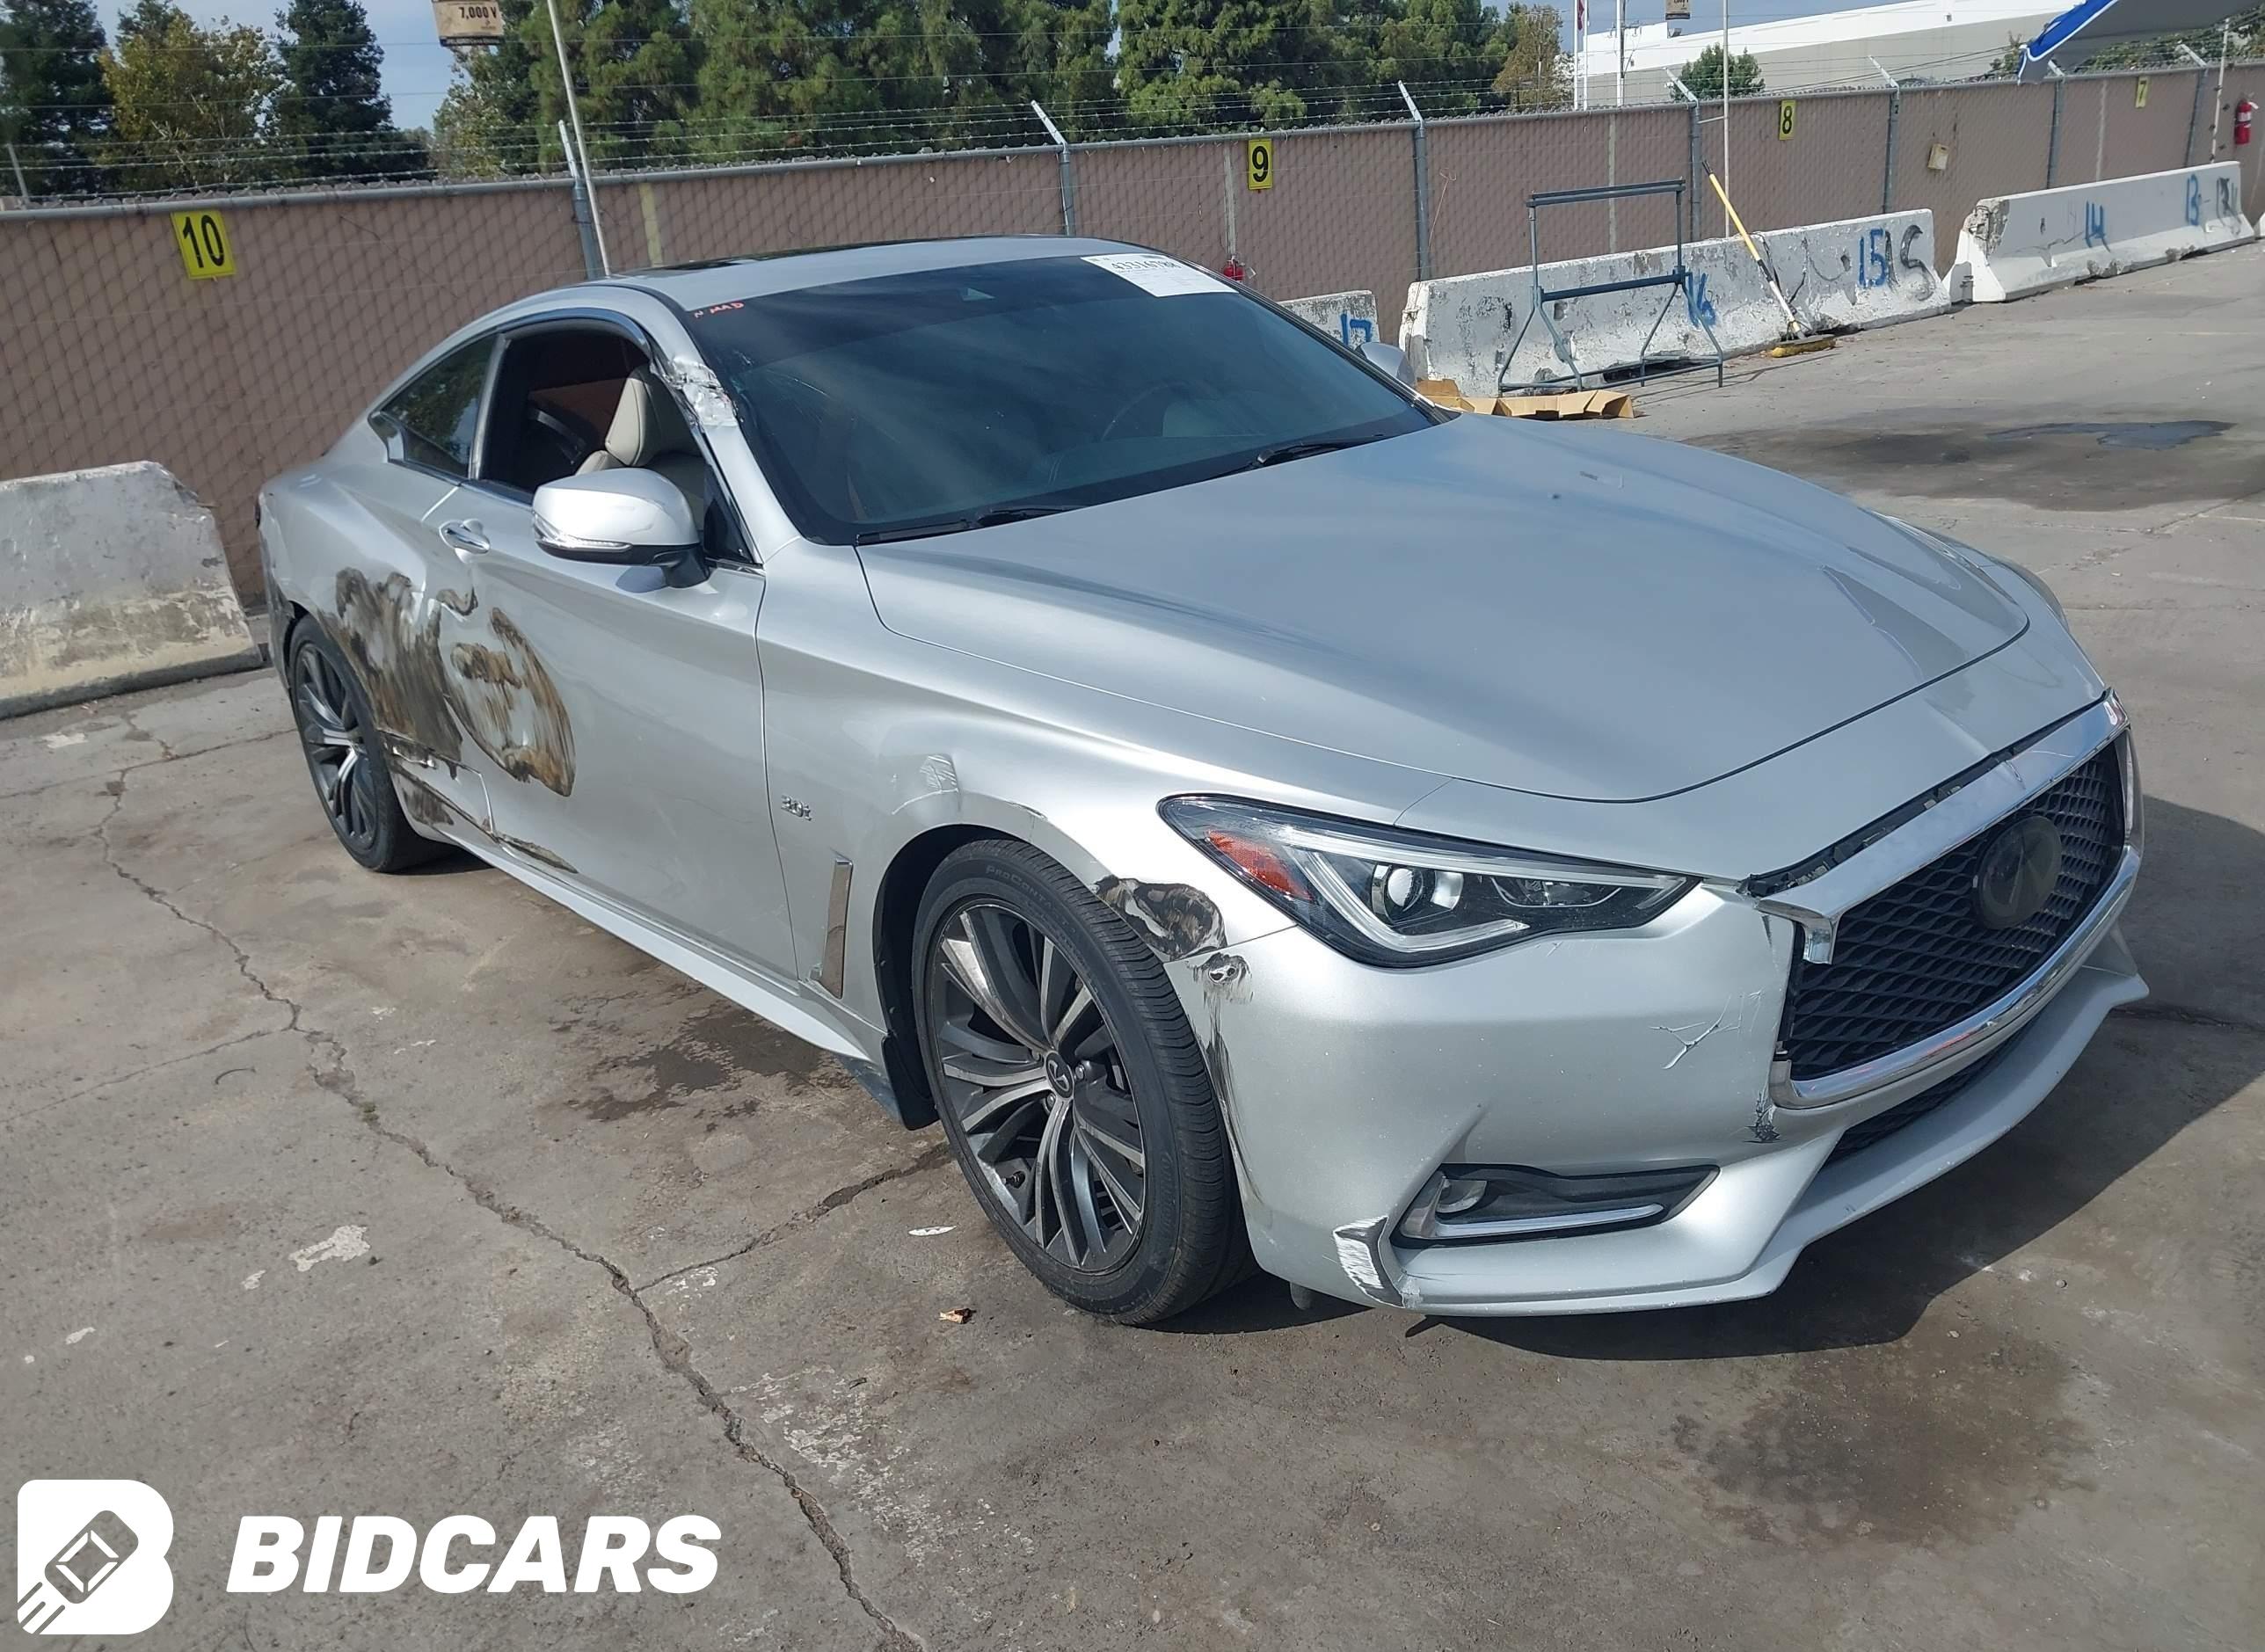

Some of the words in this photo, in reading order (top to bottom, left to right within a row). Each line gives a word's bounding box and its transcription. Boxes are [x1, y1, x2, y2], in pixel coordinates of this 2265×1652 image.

[458, 6, 490, 19] 7,000
[2138, 80, 2146, 102] 7
[1782, 106, 1793, 135] 8
[1252, 145, 1269, 183] 9
[183, 215, 225, 269] 10
